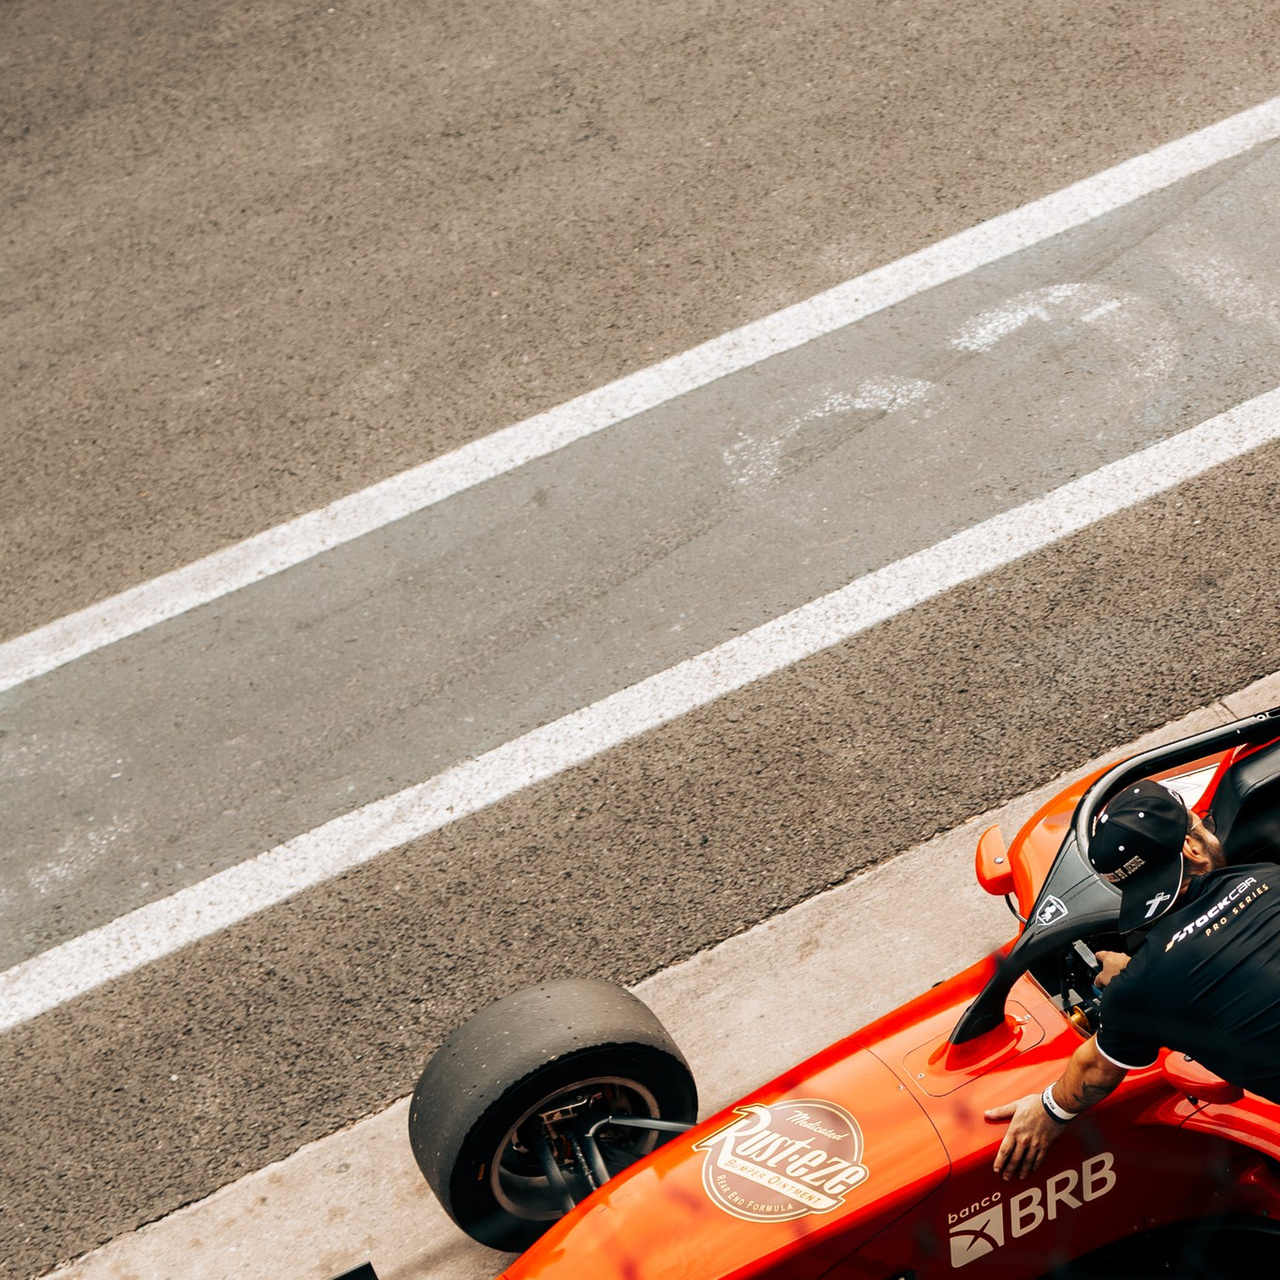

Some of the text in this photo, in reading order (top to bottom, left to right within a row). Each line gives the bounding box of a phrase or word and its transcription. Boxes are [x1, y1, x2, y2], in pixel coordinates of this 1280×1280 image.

[1205, 883, 1269, 937] PRO SERIES
[785, 1110, 849, 1141] Medicated
[715, 1174, 793, 1212] REAR END FORMULA
[724, 1158, 823, 1204] BUMPER OINTMENT
[1010, 1152, 1117, 1239] BRB
[948, 1191, 1001, 1224] banco
